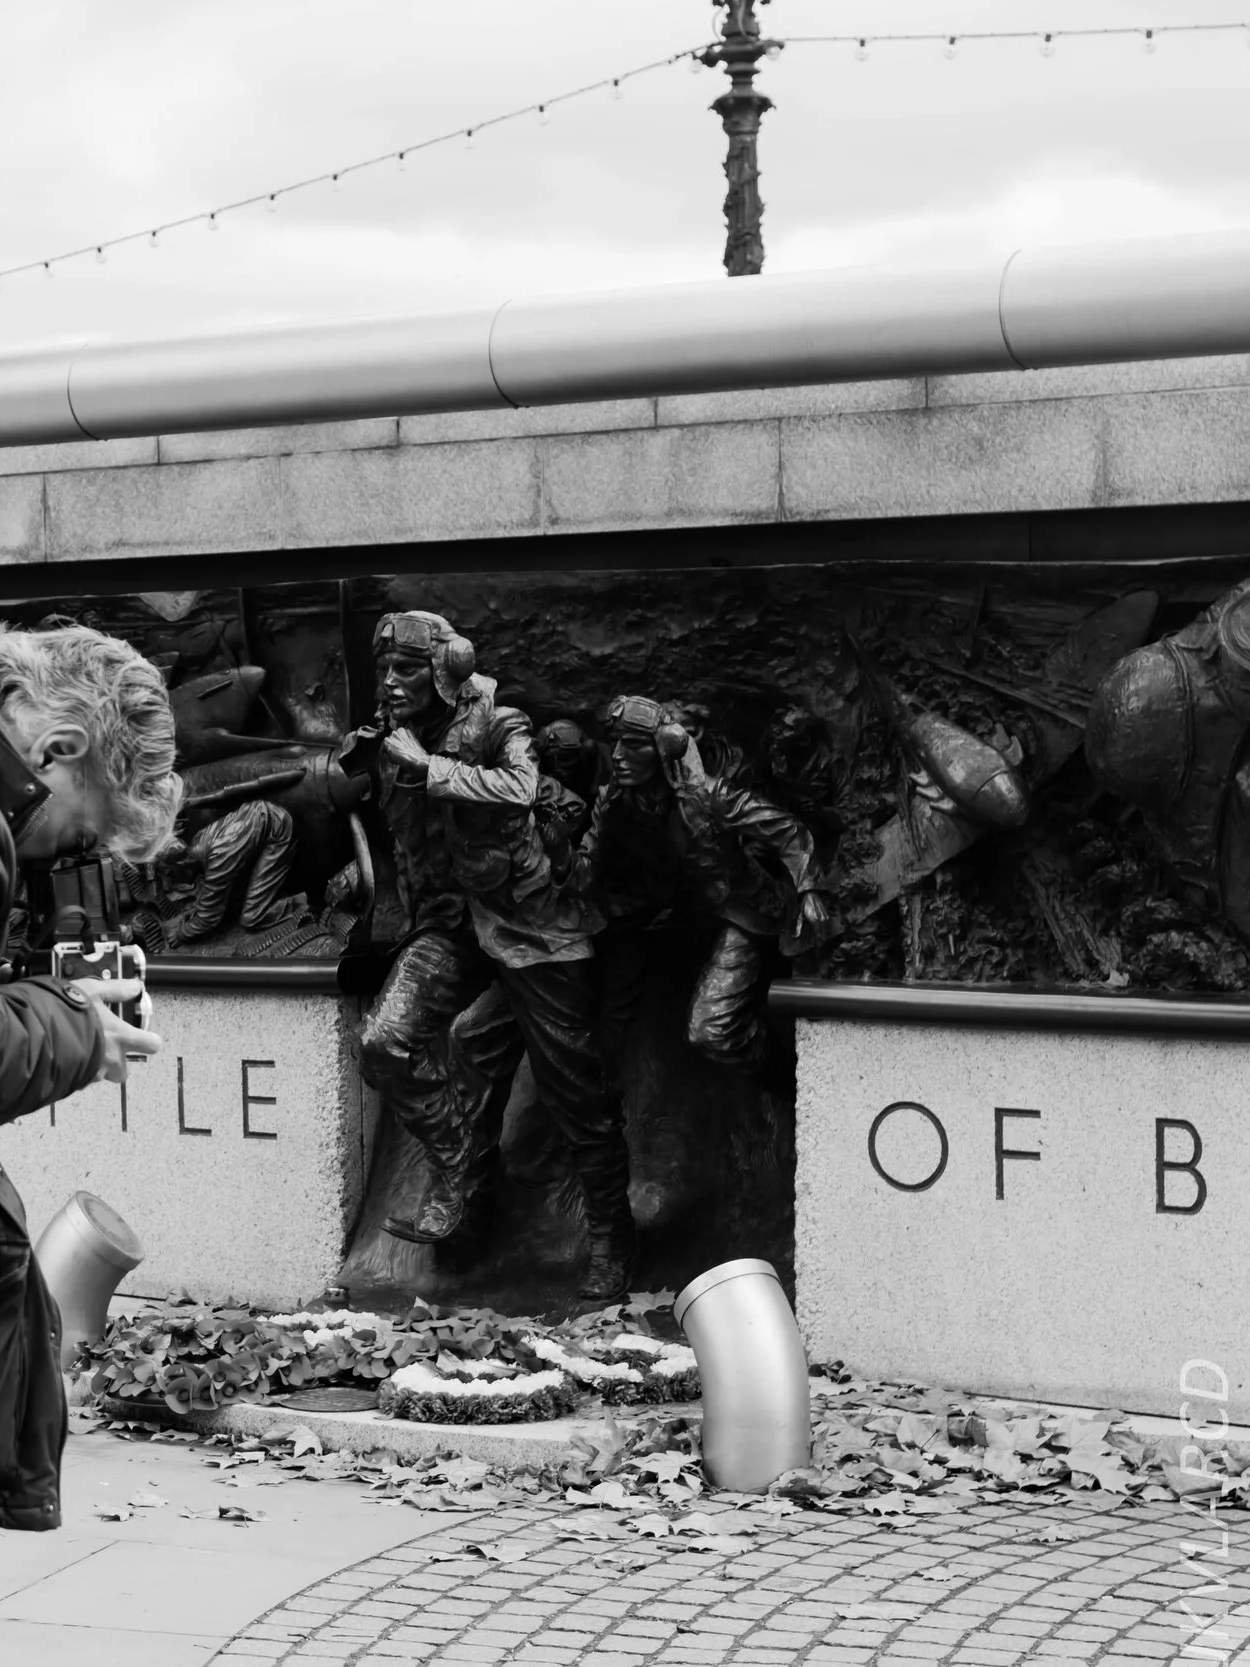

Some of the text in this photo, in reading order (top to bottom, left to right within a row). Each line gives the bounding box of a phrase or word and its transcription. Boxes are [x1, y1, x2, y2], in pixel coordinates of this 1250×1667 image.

[49, 1055, 1207, 1215] TLE OF B
